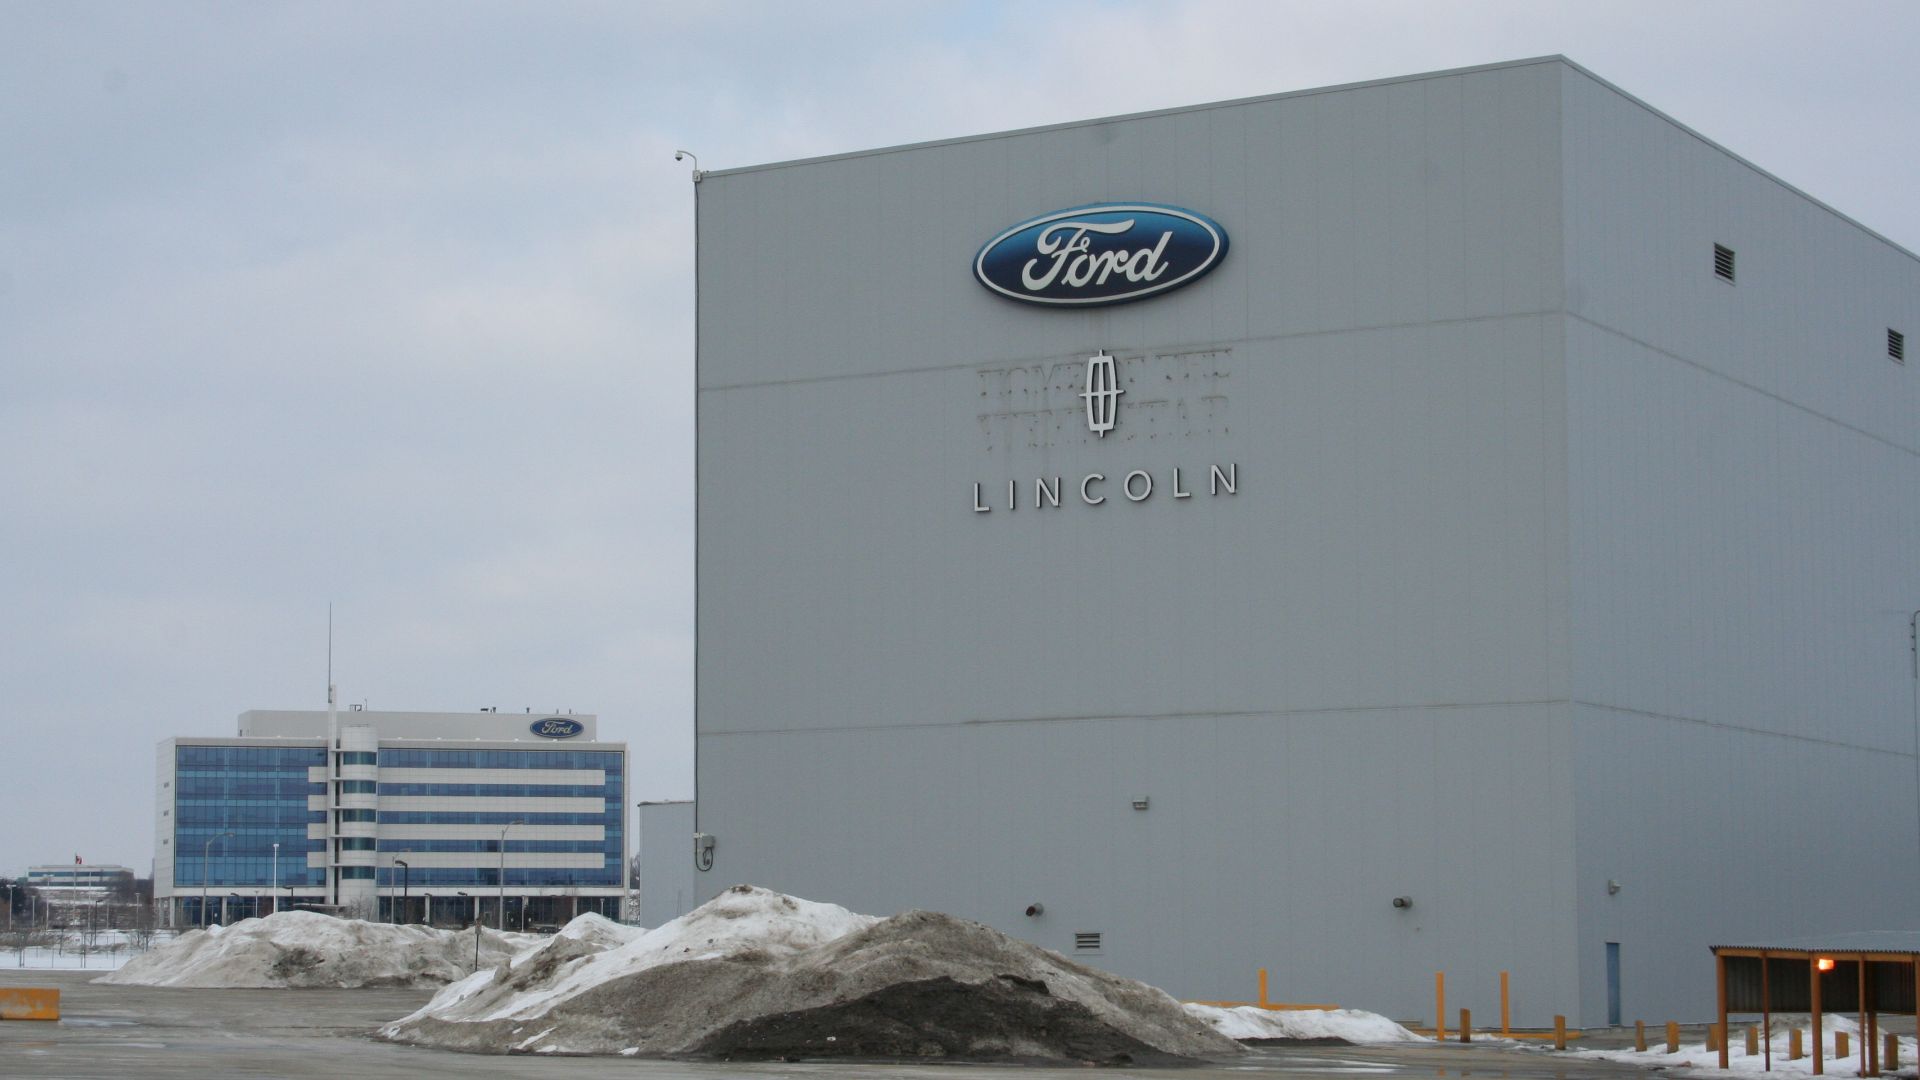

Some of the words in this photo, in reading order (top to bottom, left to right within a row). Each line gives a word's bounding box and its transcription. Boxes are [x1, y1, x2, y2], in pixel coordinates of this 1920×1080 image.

[1021, 218, 1173, 291] Ford
[974, 463, 1237, 512] LINCOLN
[541, 720, 574, 734] Ford
